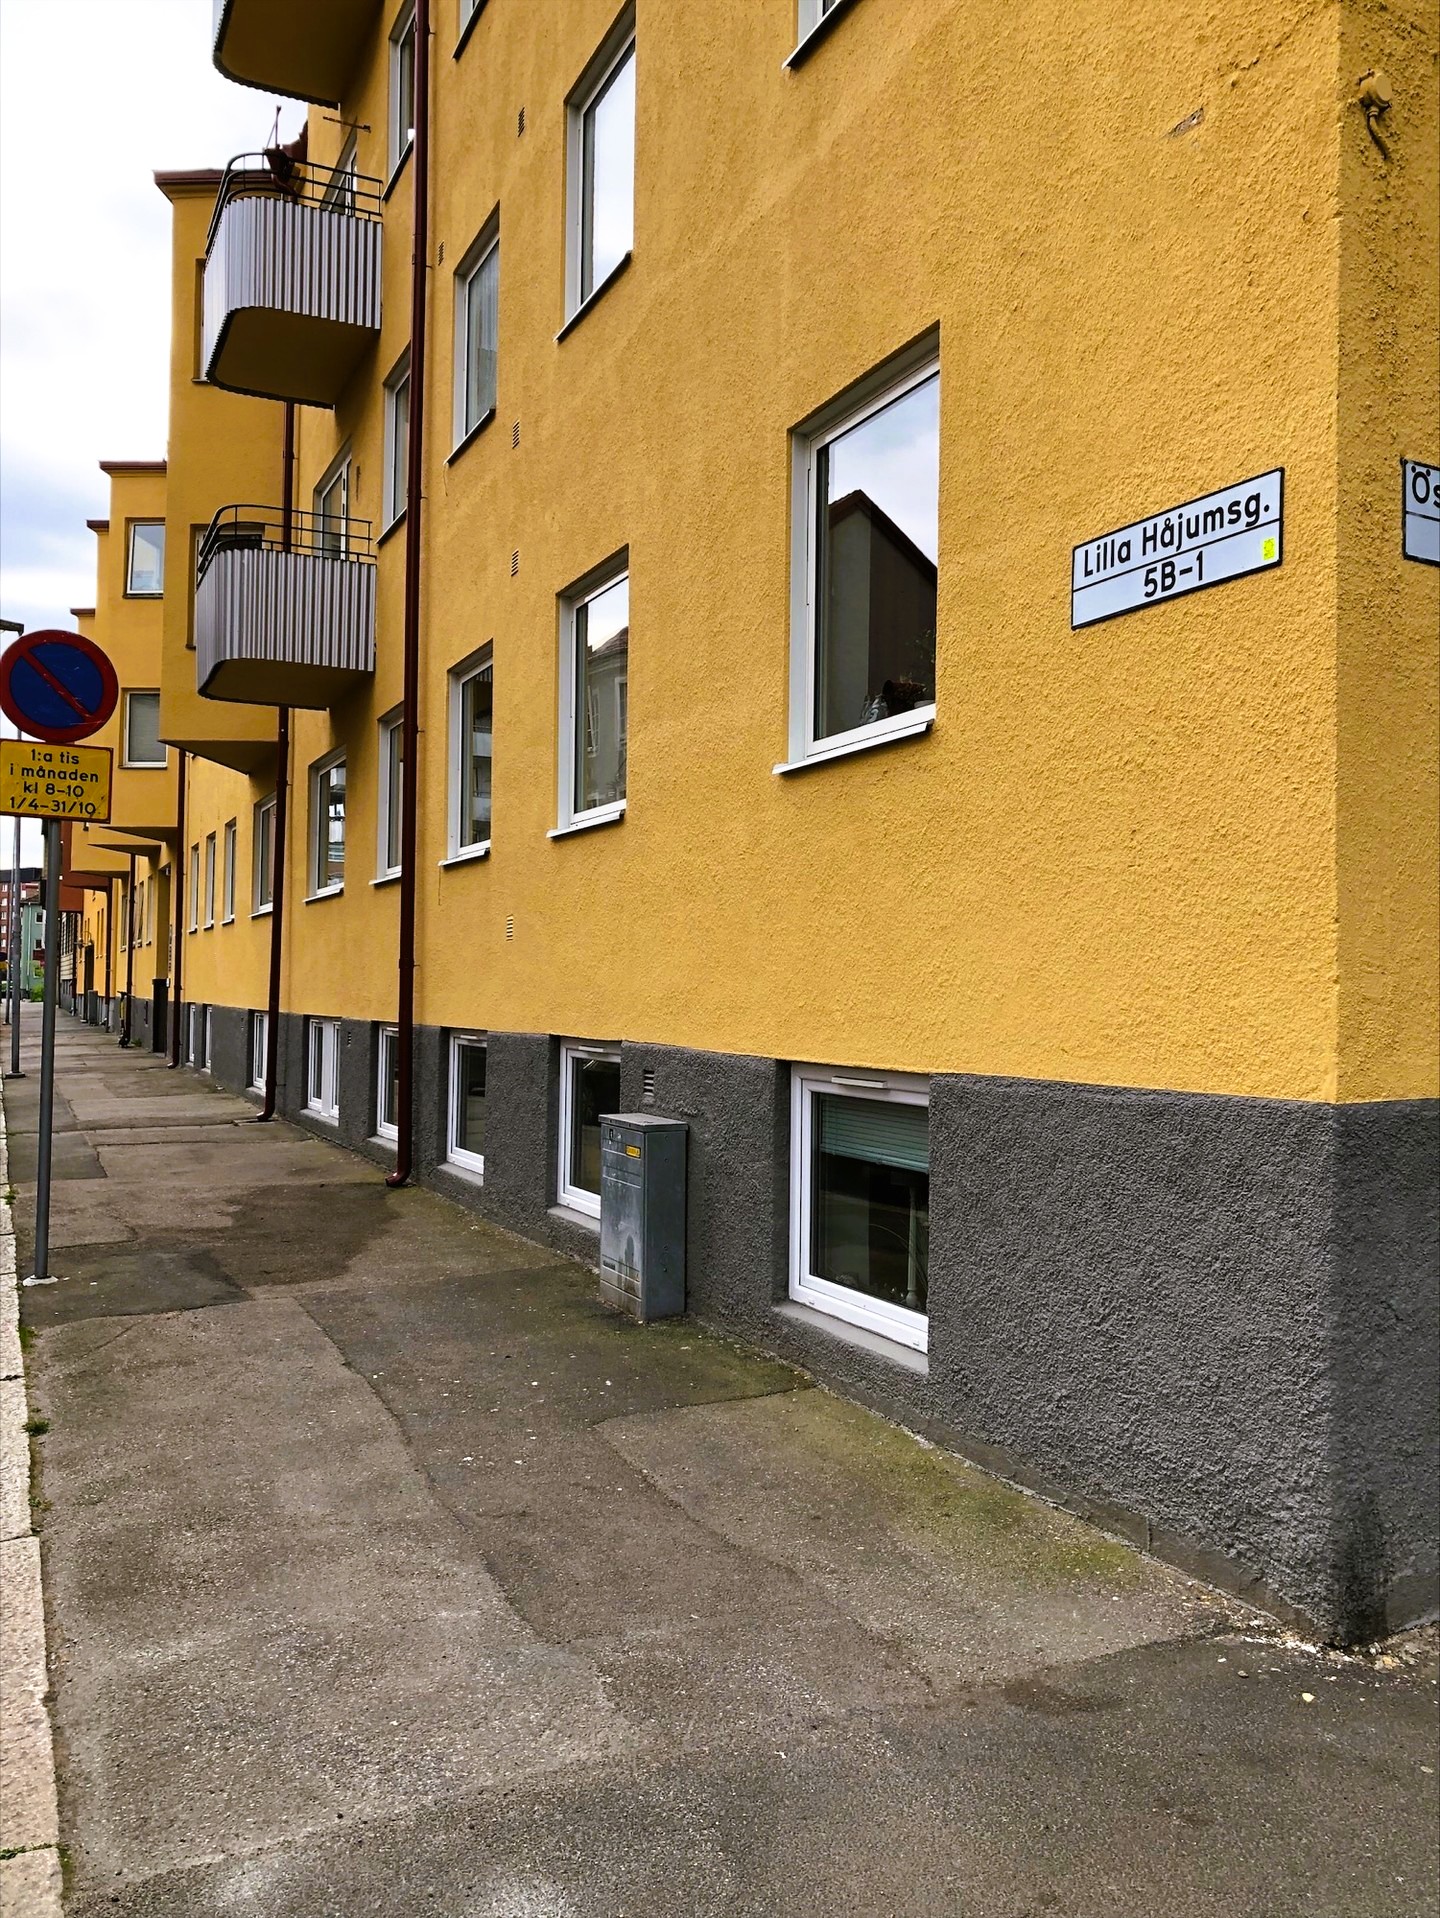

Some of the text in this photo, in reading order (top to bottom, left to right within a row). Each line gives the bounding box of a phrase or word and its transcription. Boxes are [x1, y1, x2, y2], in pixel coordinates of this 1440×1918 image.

[1083, 492, 1270, 578] Lilla Håjumsg.
[1143, 550, 1204, 598] 5B-1
[31, 748, 80, 765] 1:a tis
[10, 763, 99, 783] i månaden
[23, 781, 84, 798] kl 8-10
[10, 796, 96, 815] 1/4-31/10
